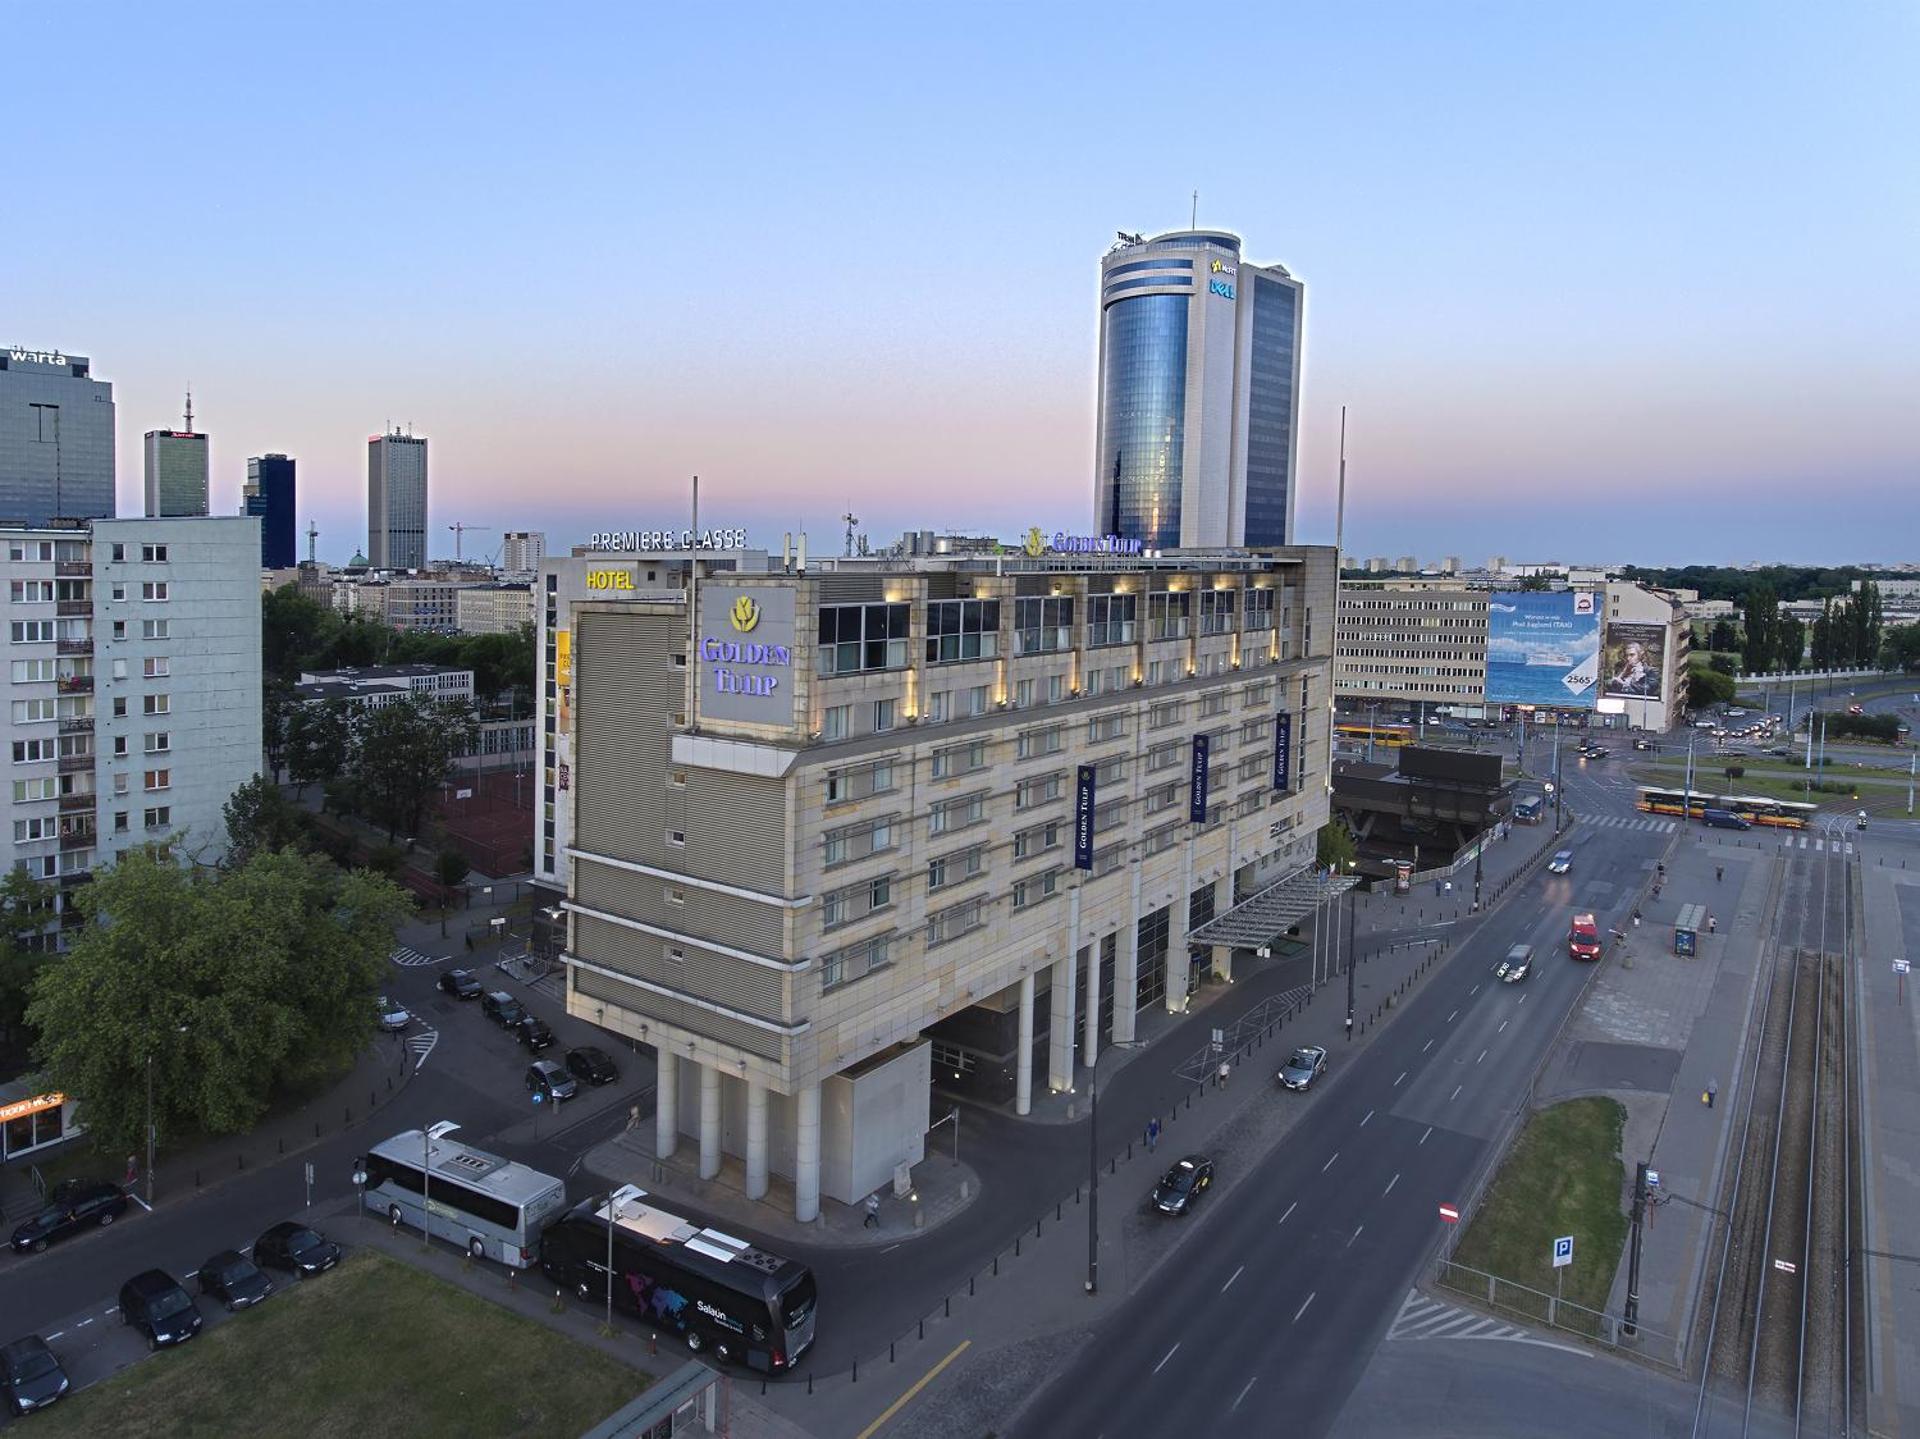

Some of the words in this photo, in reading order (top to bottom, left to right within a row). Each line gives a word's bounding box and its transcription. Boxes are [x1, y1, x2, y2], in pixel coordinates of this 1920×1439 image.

[10, 350, 66, 366] warta
[591, 531, 674, 550] PREMIERE
[587, 570, 634, 590] HOTEL
[701, 637, 791, 666] GOLDEN
[714, 668, 777, 696] TULIP
[1567, 675, 1591, 685] 2565
[1196, 752, 1205, 774] TULIP
[1081, 786, 1090, 810] TULIP
[1195, 775, 1204, 805] GOLDEN
[1079, 810, 1089, 849] GOLDEN
[1560, 1241, 1569, 1256] P
